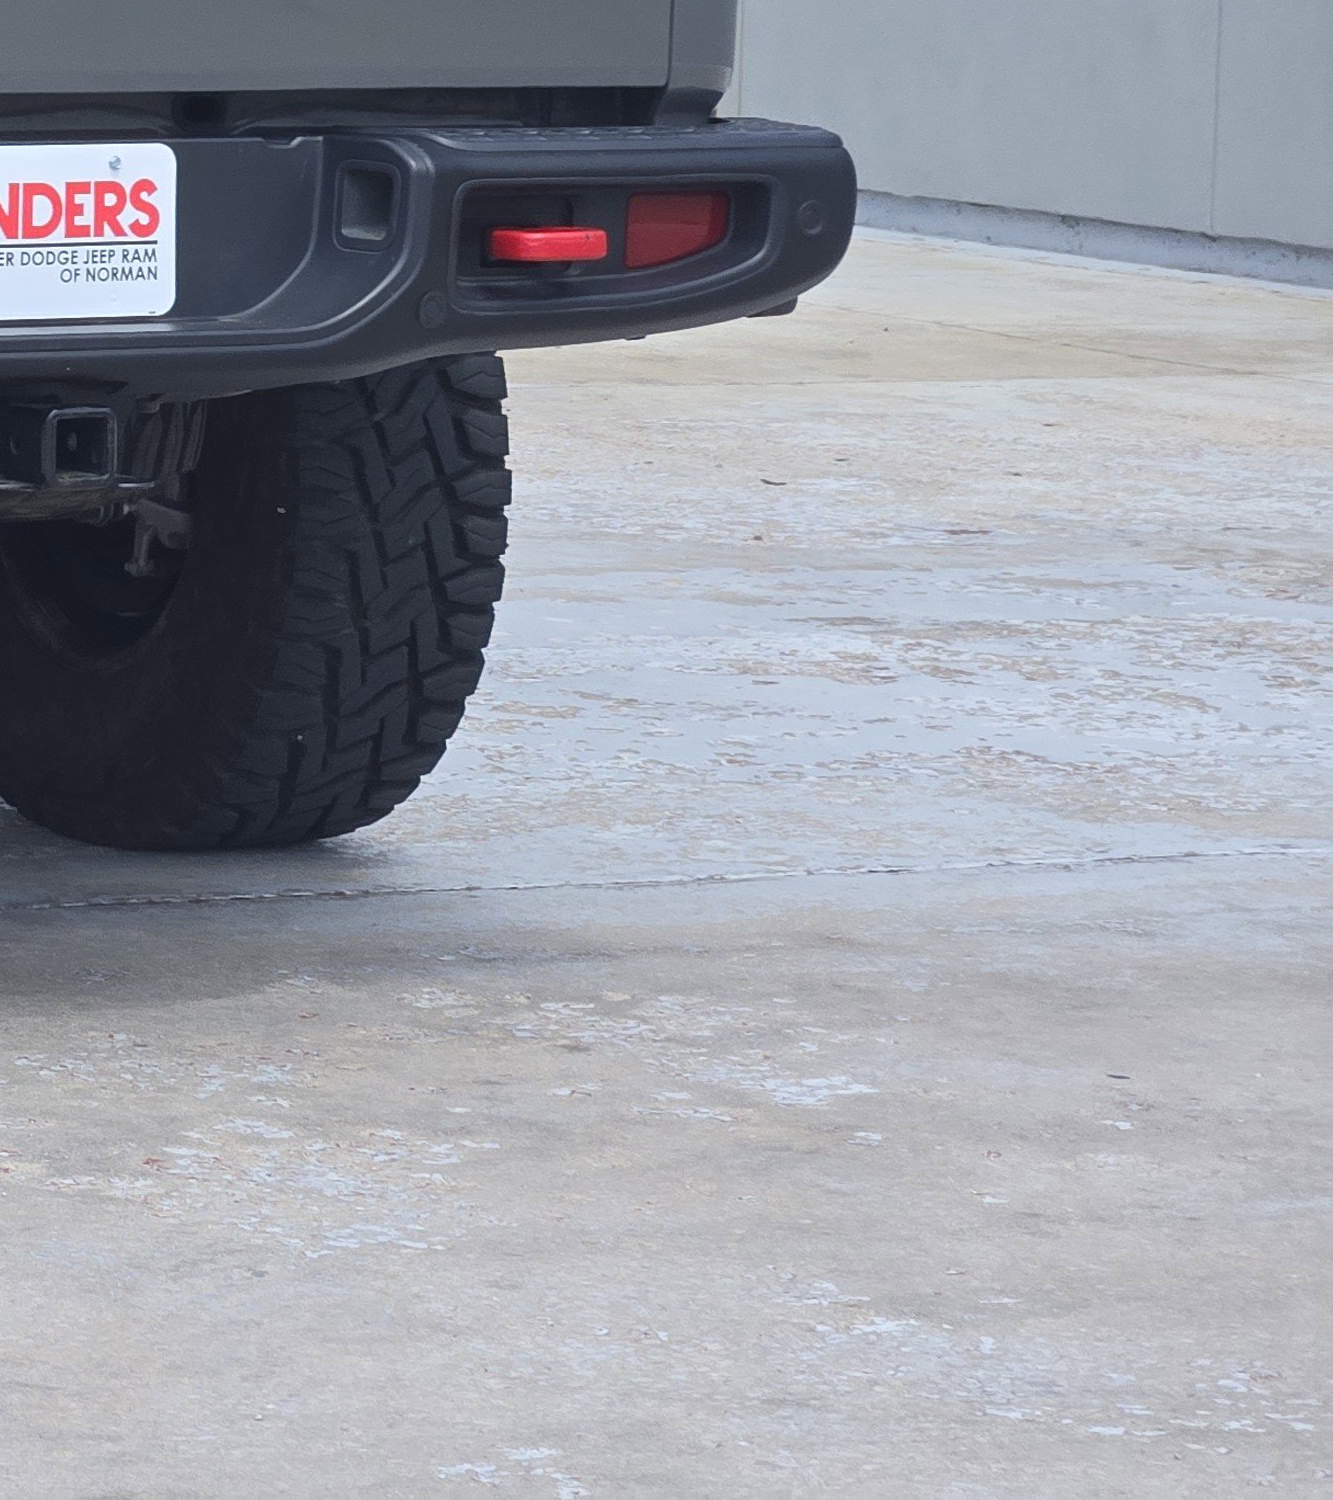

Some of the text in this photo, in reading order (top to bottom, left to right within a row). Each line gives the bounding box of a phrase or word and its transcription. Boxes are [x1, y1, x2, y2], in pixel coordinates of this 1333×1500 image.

[20, 250, 79, 267] DODGE
[83, 249, 116, 265] JEEP
[121, 248, 158, 263] RAM
[60, 266, 158, 283] OF NORMAN
